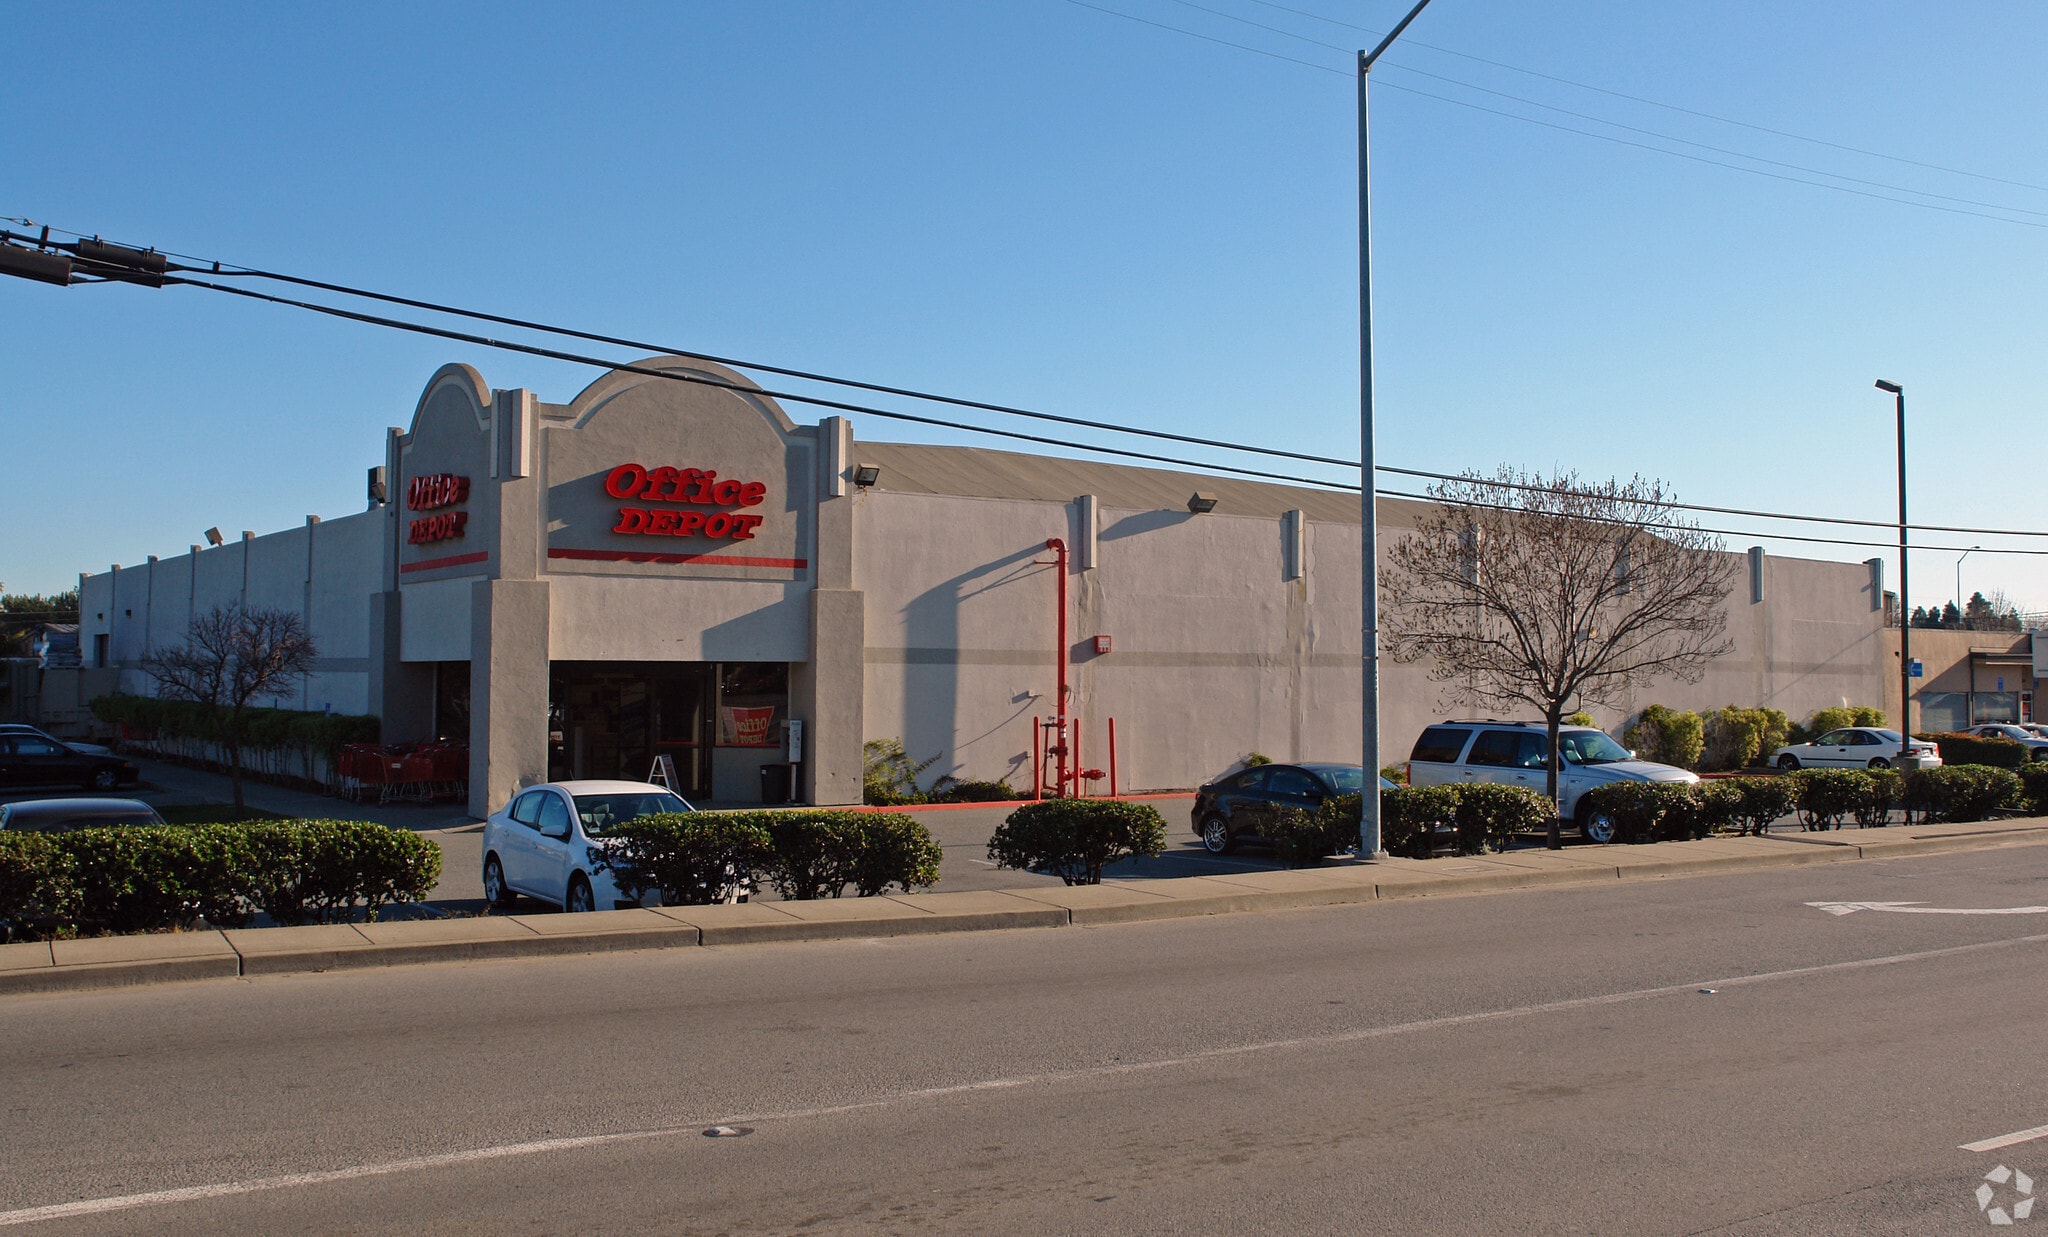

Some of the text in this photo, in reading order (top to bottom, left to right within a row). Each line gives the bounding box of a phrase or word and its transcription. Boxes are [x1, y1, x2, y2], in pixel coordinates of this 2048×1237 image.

[407, 473, 469, 511] Office
[605, 463, 766, 506] Office
[408, 512, 467, 545] DEPOT
[613, 507, 763, 539] DEPOT
